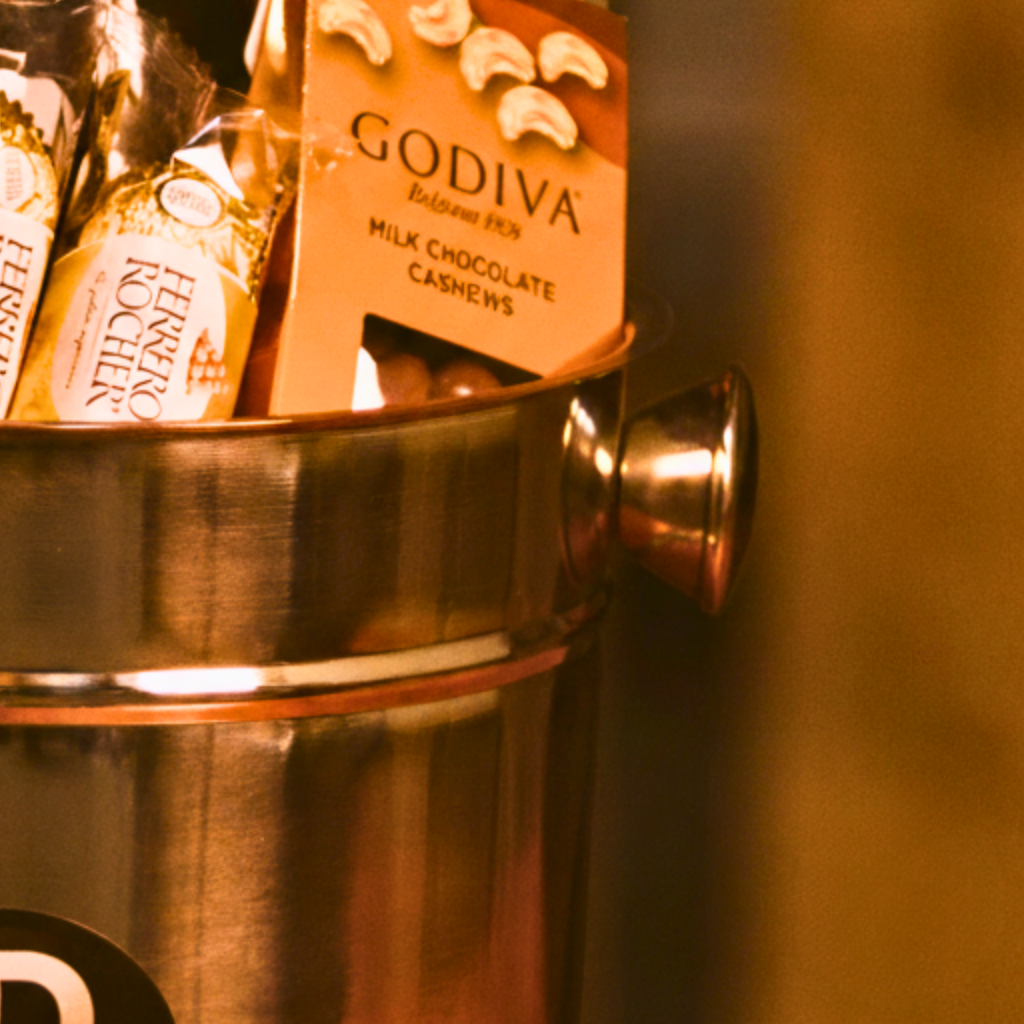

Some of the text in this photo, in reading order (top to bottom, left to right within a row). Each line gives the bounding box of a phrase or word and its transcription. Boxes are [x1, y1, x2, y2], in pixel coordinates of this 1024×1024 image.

[350, 111, 581, 235] GODIVA
[369, 216, 557, 303] MILK CHOCOLATE
[408, 261, 515, 317] CASHEWS
[85, 256, 162, 407] ROCHER
[127, 265, 196, 421] FERRERO
